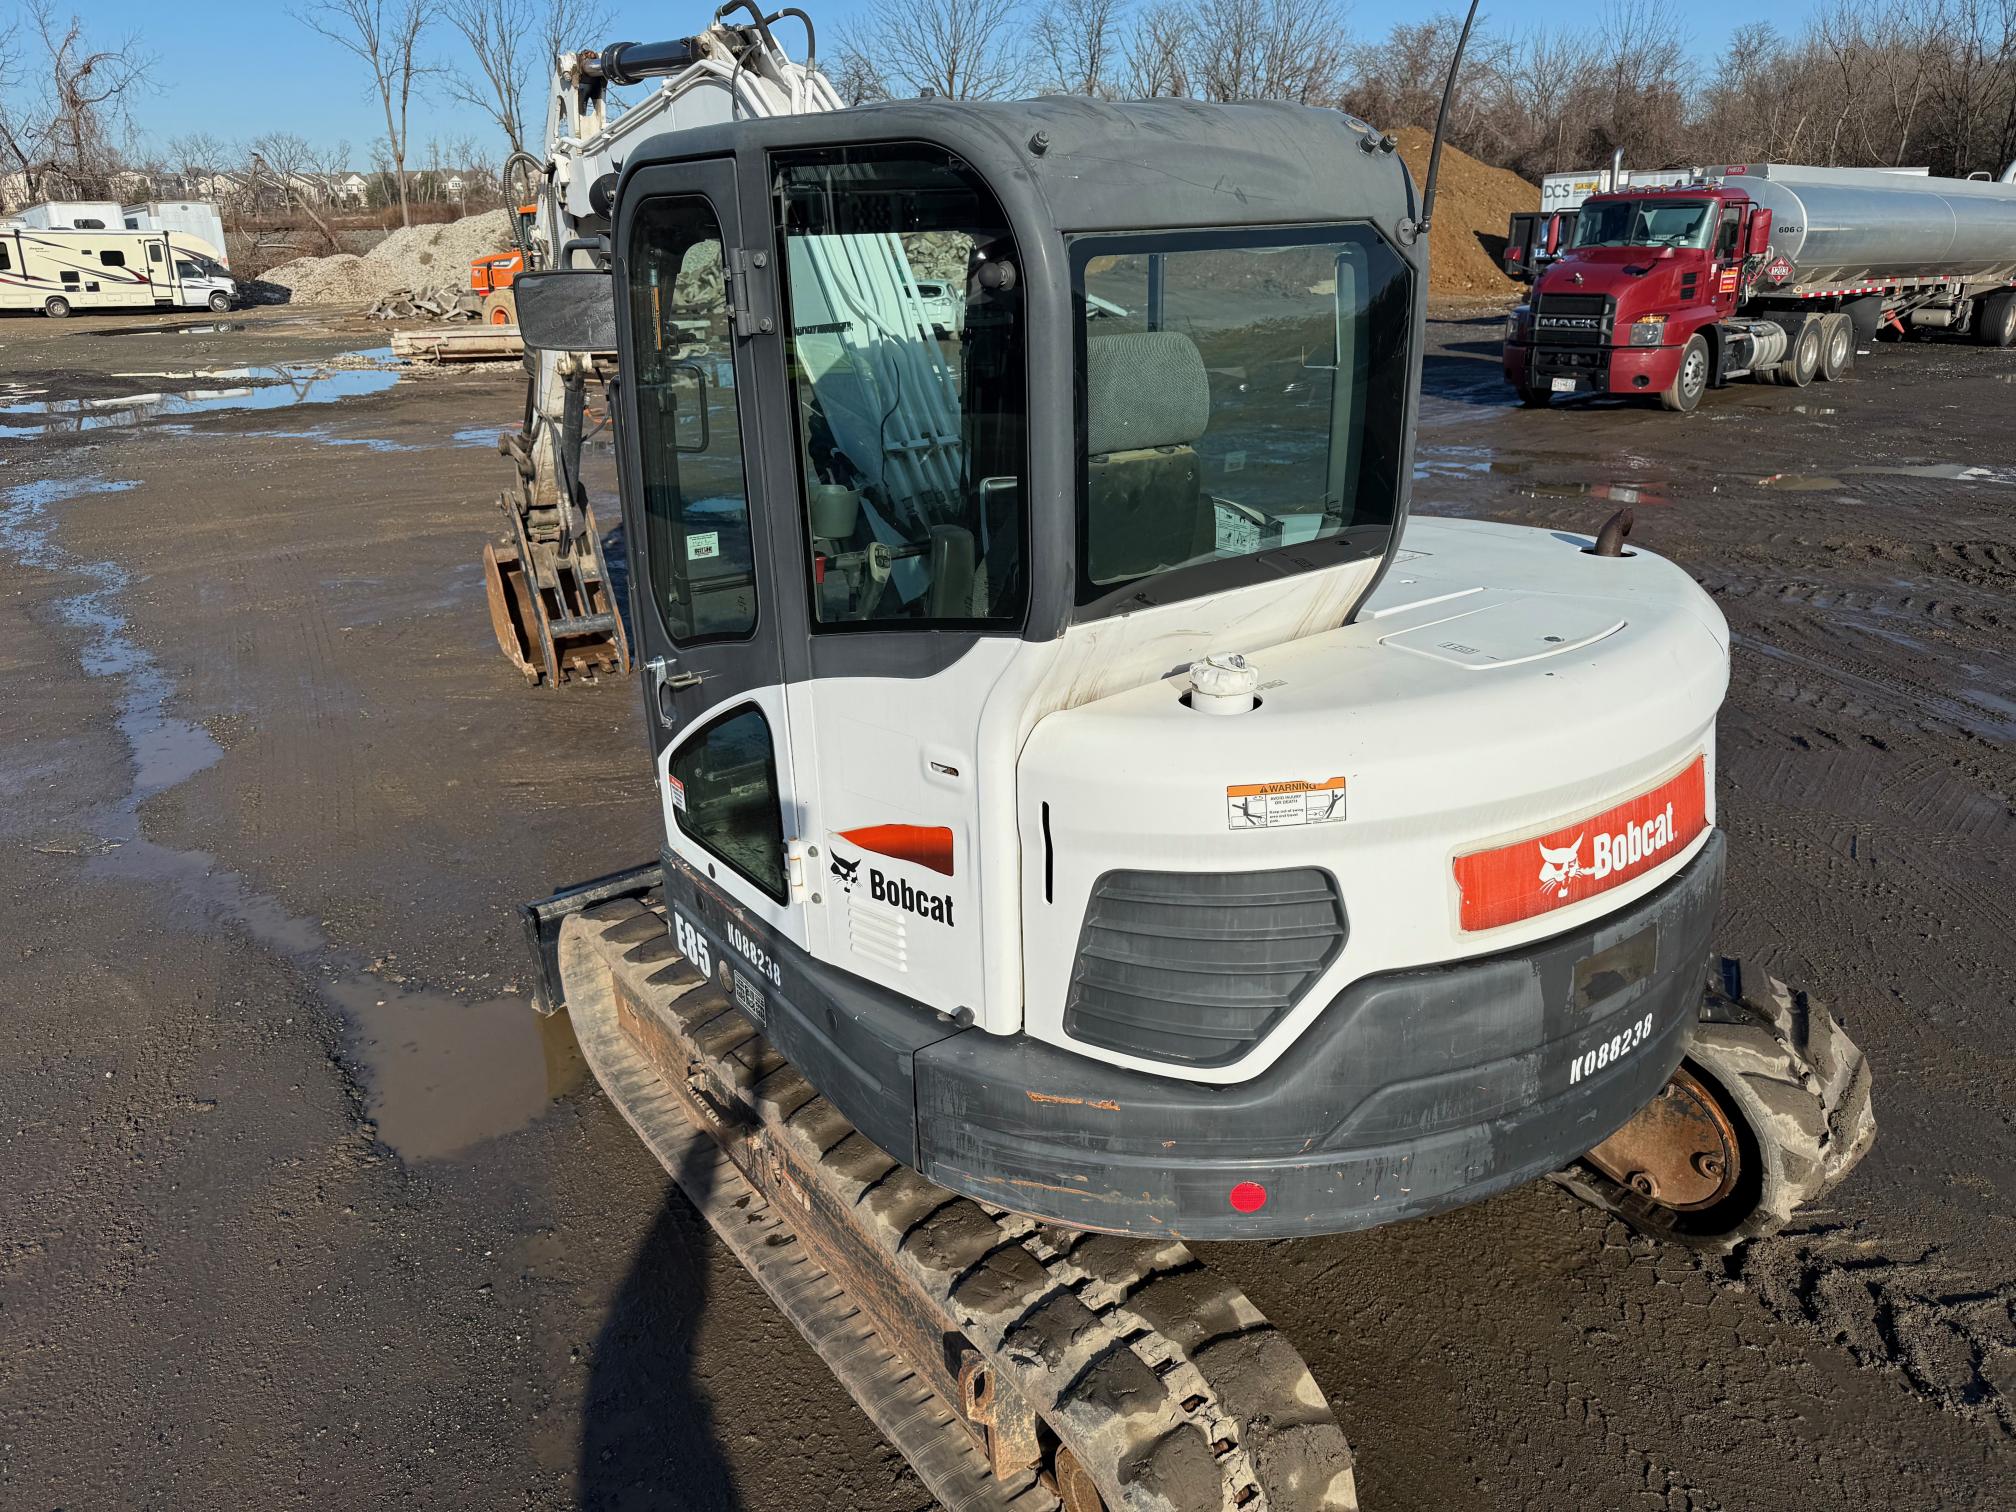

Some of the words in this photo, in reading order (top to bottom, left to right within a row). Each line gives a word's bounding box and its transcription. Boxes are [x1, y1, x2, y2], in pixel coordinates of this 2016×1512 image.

[1544, 183, 1570, 199] DCS
[1540, 318, 1599, 329] MACK
[1269, 783, 1316, 793] WARNING
[1593, 801, 1674, 880] Bobcat
[869, 868, 954, 927] Bobcat
[674, 911, 712, 978] E85
